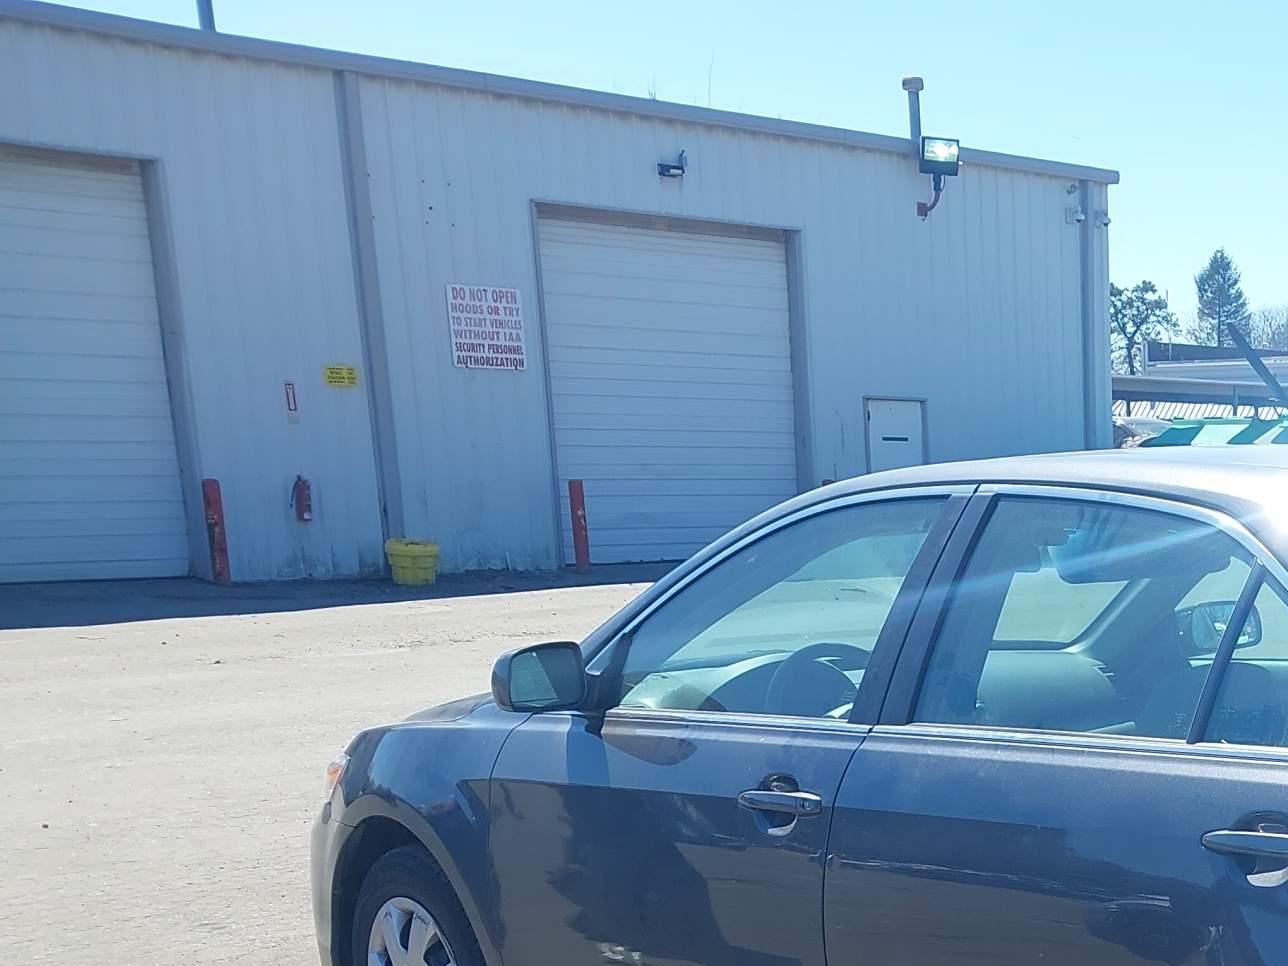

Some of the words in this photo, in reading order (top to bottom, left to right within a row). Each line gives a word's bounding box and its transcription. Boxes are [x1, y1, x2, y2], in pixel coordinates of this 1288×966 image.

[451, 287, 465, 300] DO
[469, 288, 488, 302] NOT
[491, 289, 517, 304] OPEN
[450, 302, 484, 314] HOODS
[487, 305, 500, 316] OR
[503, 306, 520, 317] TRY
[451, 316, 462, 327] TO
[464, 317, 487, 328] START
[489, 318, 522, 330] VEHICLES
[453, 329, 500, 341] WITHOUT
[455, 342, 486, 353] SECURITY
[488, 343, 524, 355] PERSONNEL
[456, 355, 525, 368] AUTHORIZATION
